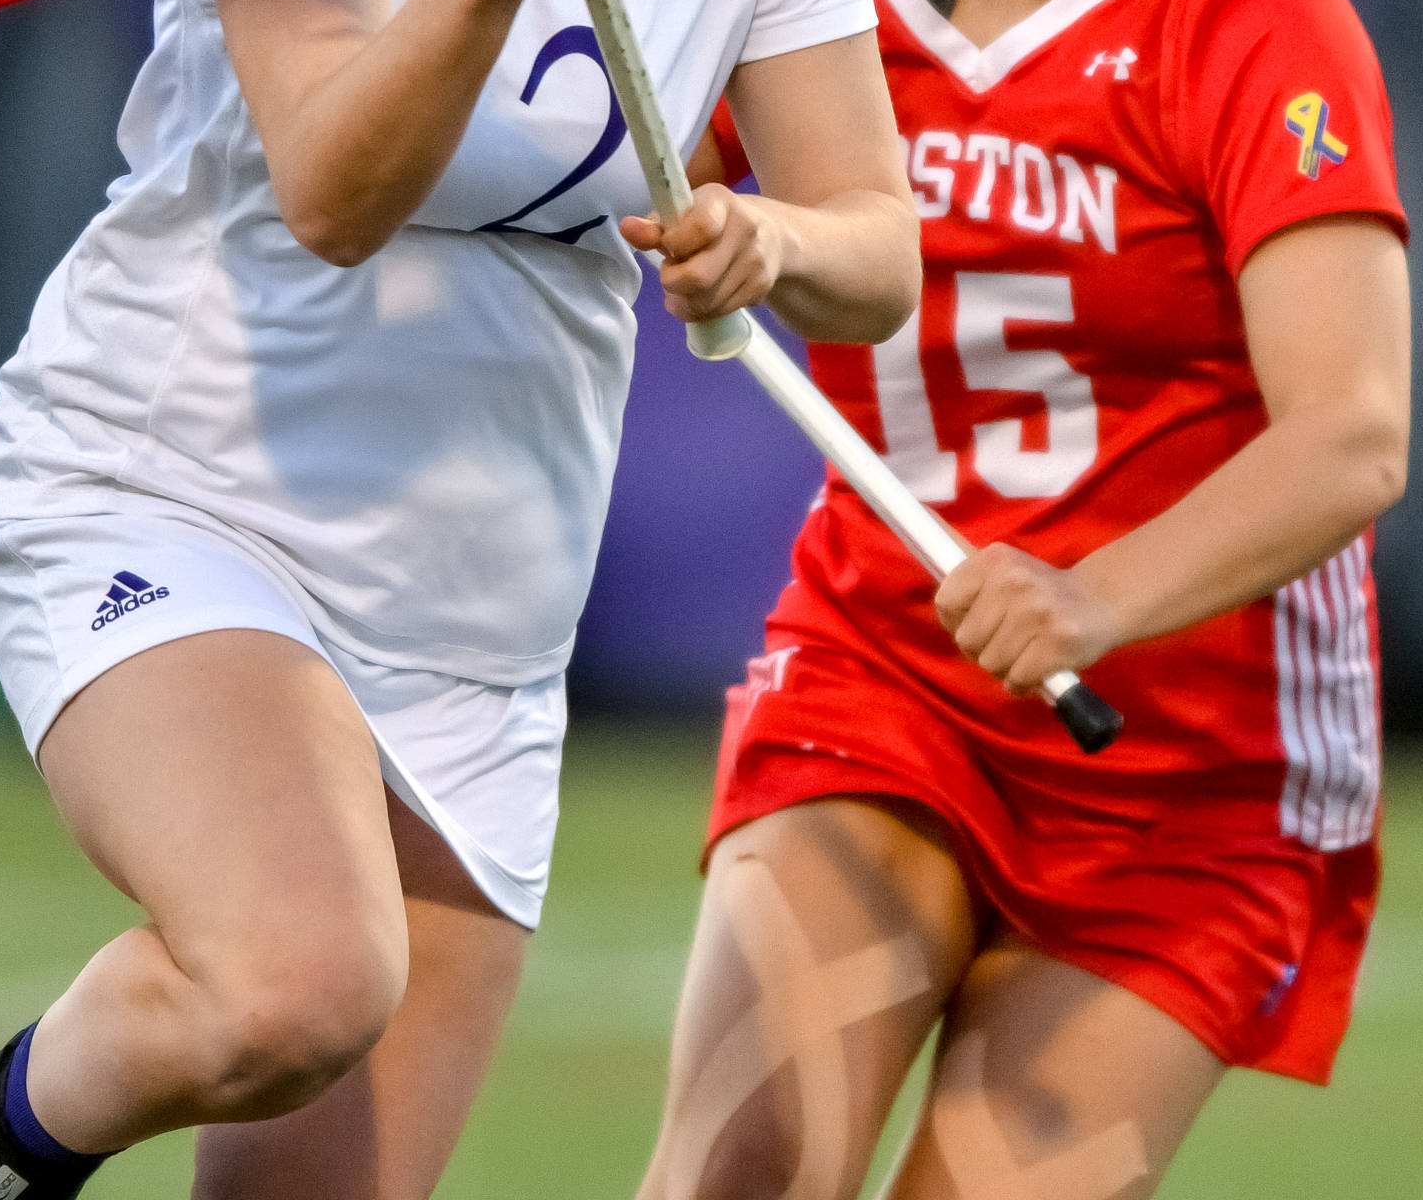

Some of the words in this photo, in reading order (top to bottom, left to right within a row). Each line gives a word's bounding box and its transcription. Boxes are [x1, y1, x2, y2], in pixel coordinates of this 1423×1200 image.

[475, 25, 629, 246] 2
[899, 131, 1119, 255] STON
[872, 271, 1101, 503] 15
[91, 586, 171, 632] adidas
